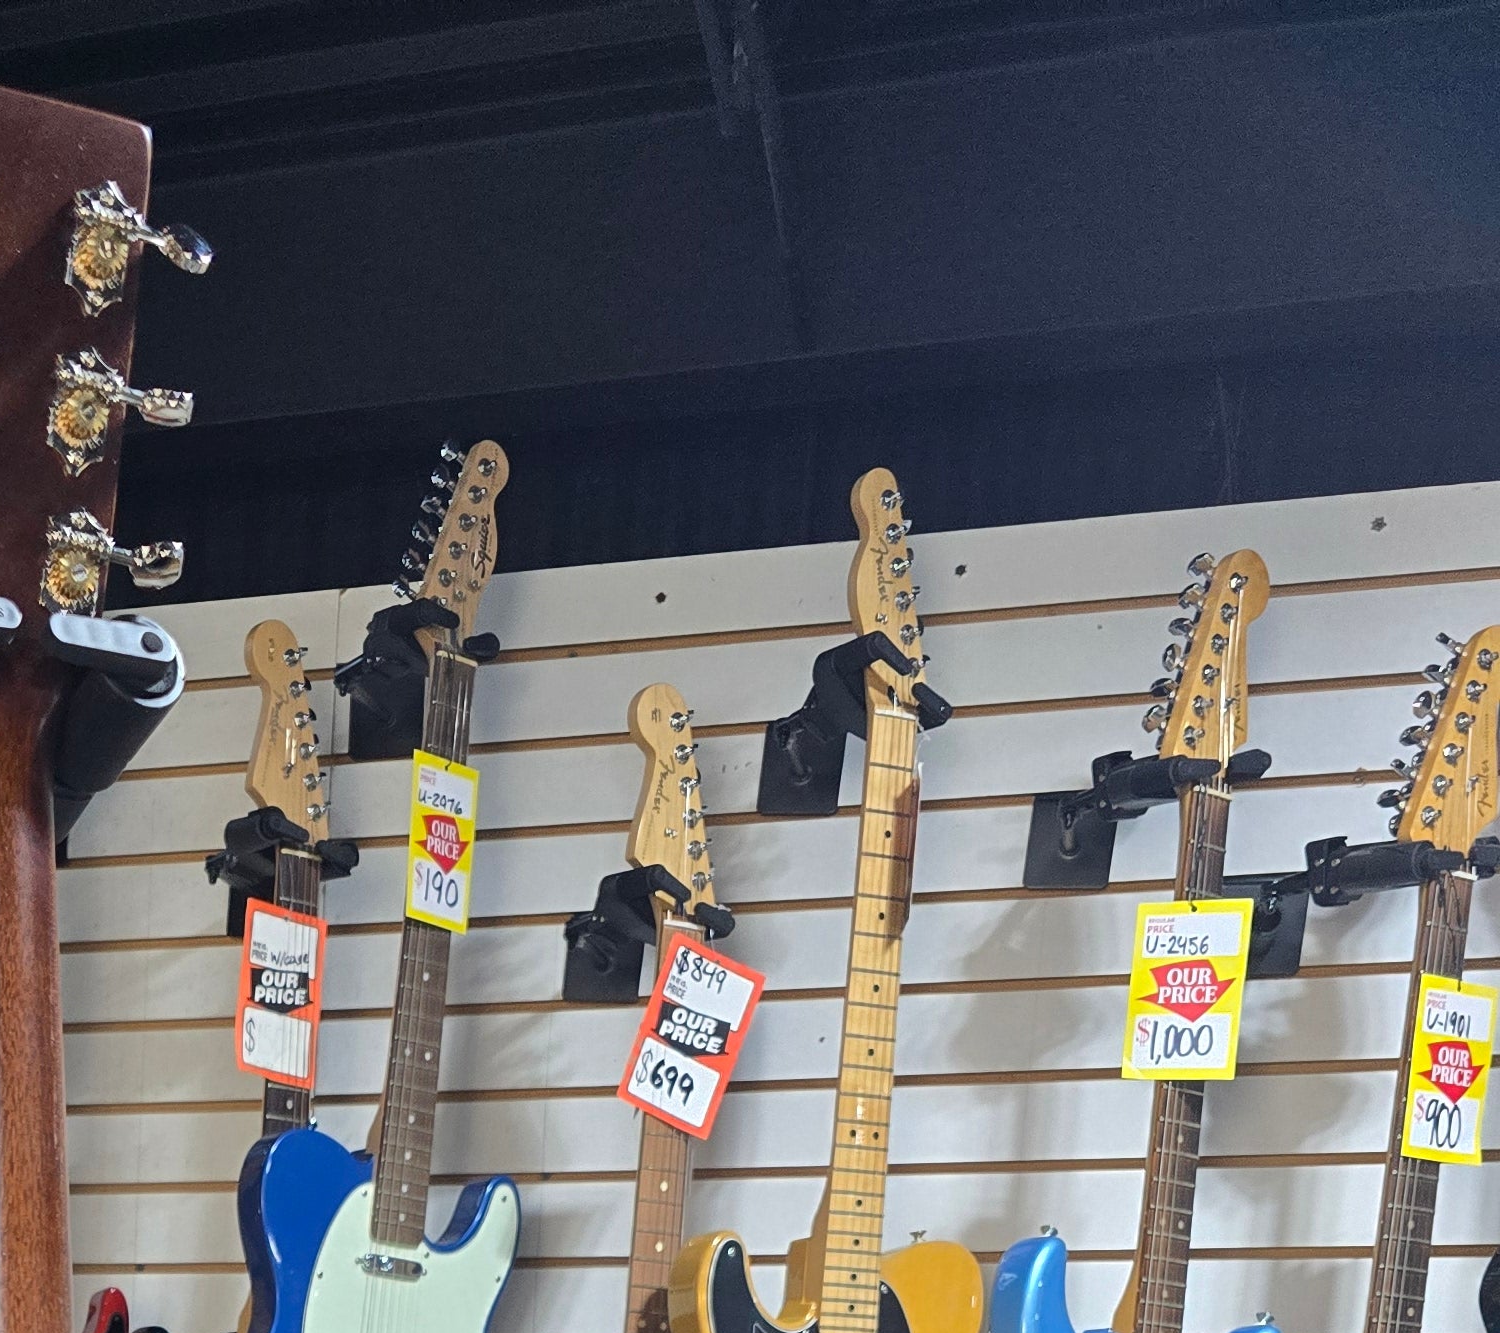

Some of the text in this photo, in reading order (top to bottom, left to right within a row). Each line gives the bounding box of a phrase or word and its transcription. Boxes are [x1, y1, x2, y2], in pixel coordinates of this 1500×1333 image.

[470, 513, 492, 579] Squier
[870, 536, 893, 603] Fender
[652, 754, 675, 815] Fender
[431, 819, 457, 842] OUR
[426, 835, 460, 861] PRICE
[415, 862, 459, 907] $190
[1147, 924, 1175, 934] PRICE
[1145, 935, 1209, 955] U-2456
[261, 969, 300, 989] OUR
[675, 949, 728, 994] $849
[1166, 967, 1213, 986] OUR
[254, 984, 307, 1006] PRICE
[666, 984, 687, 1000] PRICE
[1157, 985, 1219, 1005] PRICE
[671, 1007, 718, 1036] OUR
[658, 1024, 725, 1055] PRICE
[1136, 1017, 1214, 1065] $1,000
[1438, 1046, 1470, 1069] OUR
[635, 1050, 695, 1107] $699
[1431, 1064, 1474, 1088] PRICE
[1414, 1094, 1462, 1149] $900
